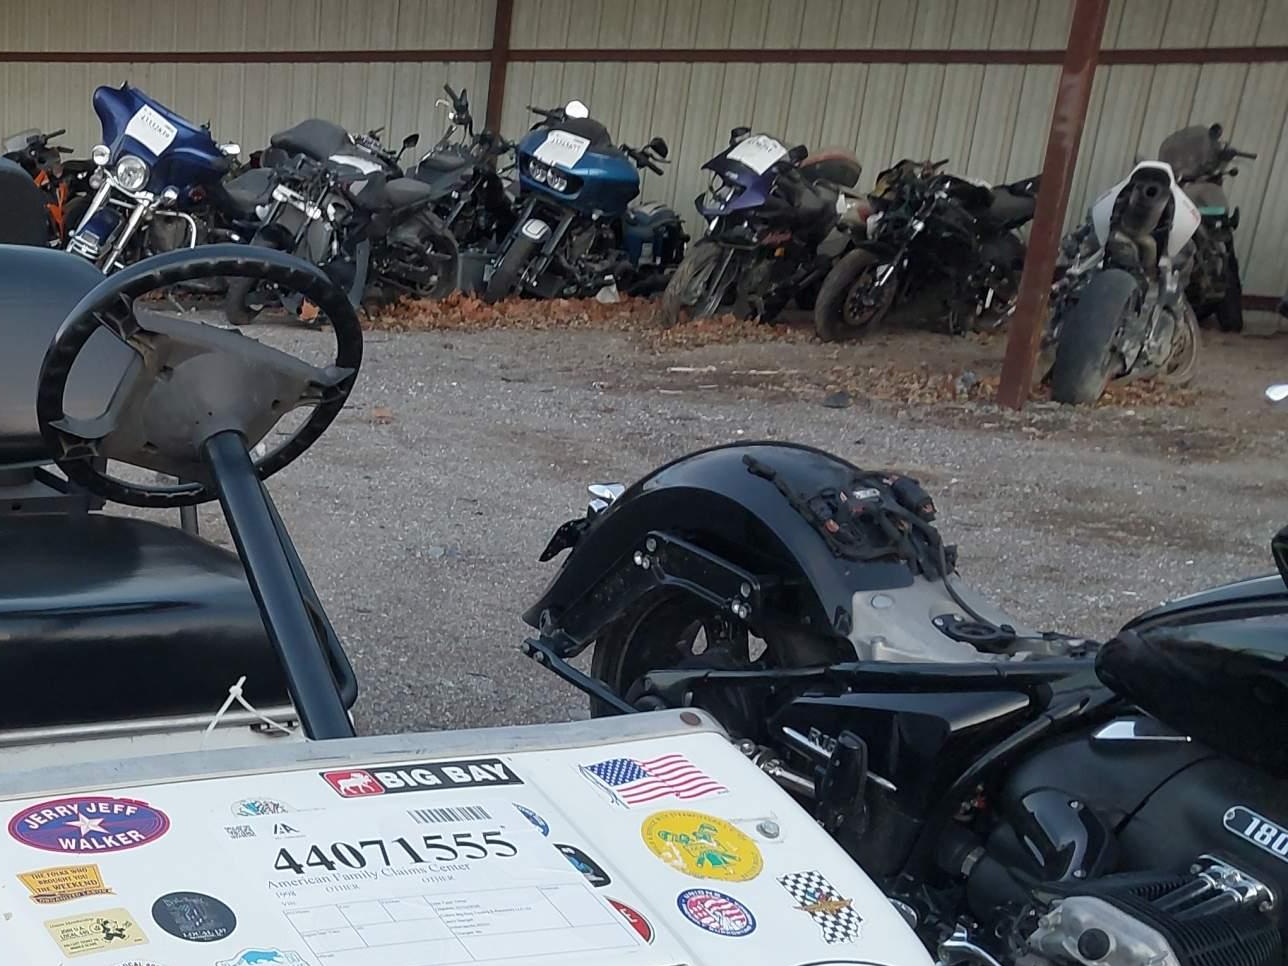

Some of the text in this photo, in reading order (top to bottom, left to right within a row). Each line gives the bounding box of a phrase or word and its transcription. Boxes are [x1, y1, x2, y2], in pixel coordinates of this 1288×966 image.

[375, 763, 510, 788] BIG BAY
[24, 802, 138, 829] JERRY JEFF
[58, 829, 146, 850] WALKER
[274, 831, 518, 875] 44071555
[52, 879, 98, 891] WEEKEND
[268, 862, 471, 889] American Family Claims Center
[326, 883, 360, 894] OTHER
[421, 874, 456, 884] OTHER
